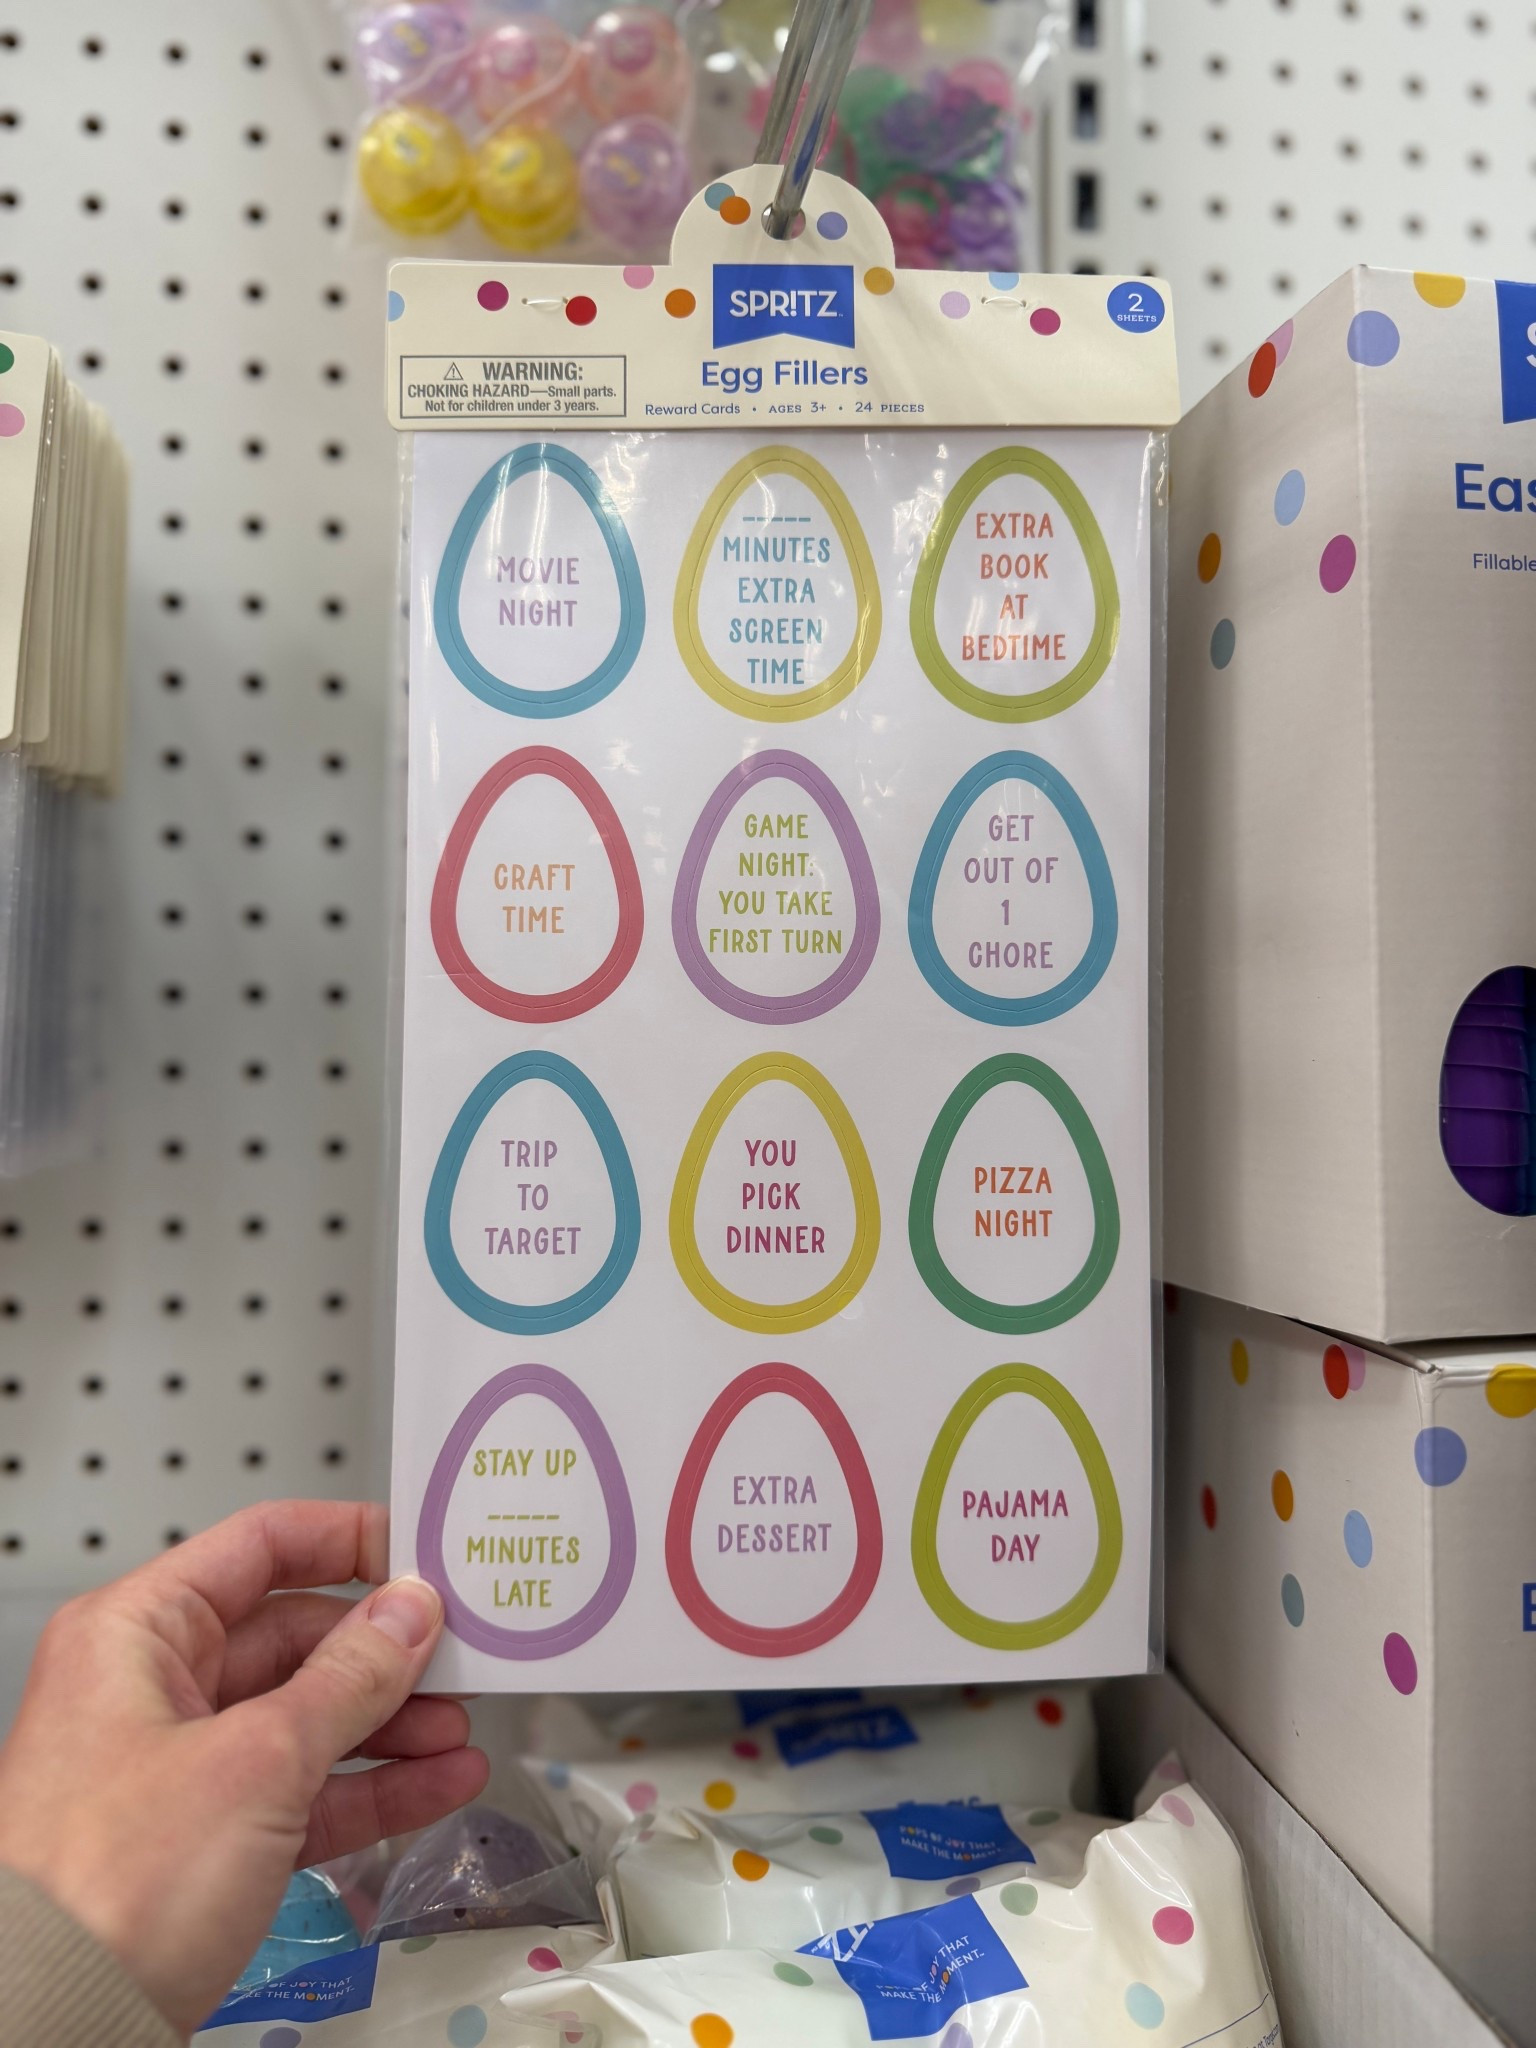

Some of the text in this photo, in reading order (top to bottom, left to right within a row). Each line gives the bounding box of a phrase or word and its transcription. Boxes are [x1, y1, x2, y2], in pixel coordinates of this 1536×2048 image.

[1128, 293, 1144, 312] 2
[1117, 314, 1157, 323] SHEETS
[482, 361, 584, 381] WARNING:
[702, 359, 869, 394] Egg Fillers
[407, 384, 469, 398] CHOKING
[583, 385, 617, 400] parts.
[425, 399, 600, 414] Not for children under 3 years.
[645, 402, 925, 416] Reward Cards AGES 3+ 24 PIECES
[976, 513, 1053, 538] EXTRA
[722, 536, 831, 564] MINUTES
[1473, 552, 1536, 572] Fillable
[496, 556, 580, 585] MOVIE
[981, 554, 1048, 579] BOOK
[739, 578, 815, 603] EXTRA
[500, 594, 577, 626] NIGHT
[1000, 594, 1028, 619] AT
[729, 618, 823, 645] SCREEN
[963, 635, 1065, 661] BEDTIME
[746, 658, 805, 685] TIME
[744, 814, 808, 839] GAME
[989, 815, 1034, 841] GET
[494, 864, 575, 890] CRAFT
[964, 857, 1058, 883] OUT OF
[719, 891, 832, 915] YOU TAKE
[1001, 900, 1009, 925] 1
[503, 906, 564, 933] TIME
[709, 929, 843, 955] FIRST TURN
[969, 942, 1053, 968] CHORE
[501, 1140, 557, 1167] TRIP
[745, 1140, 796, 1166] YOU
[975, 1167, 1051, 1193] PIZZA
[518, 1184, 548, 1210] TO
[743, 1183, 800, 1209] PICK
[976, 1210, 1052, 1236] NIGHT
[485, 1227, 581, 1255] TARGET
[727, 1226, 824, 1253] DINNER
[472, 1448, 576, 1477] STAY UP
[734, 1476, 817, 1505] EXTRA
[963, 1490, 1068, 1518] PAJAMA
[467, 1536, 579, 1564] MINUTES
[718, 1524, 831, 1553] DESSERT
[992, 1535, 1040, 1562] DAY
[494, 1580, 551, 1607] LATE
[938, 1935, 970, 1958] THAT
[267, 1991, 291, 1999] THE
[320, 1975, 353, 1989] THAT
[880, 1990, 917, 2000] MAKE
[918, 1992, 942, 2004] THE
